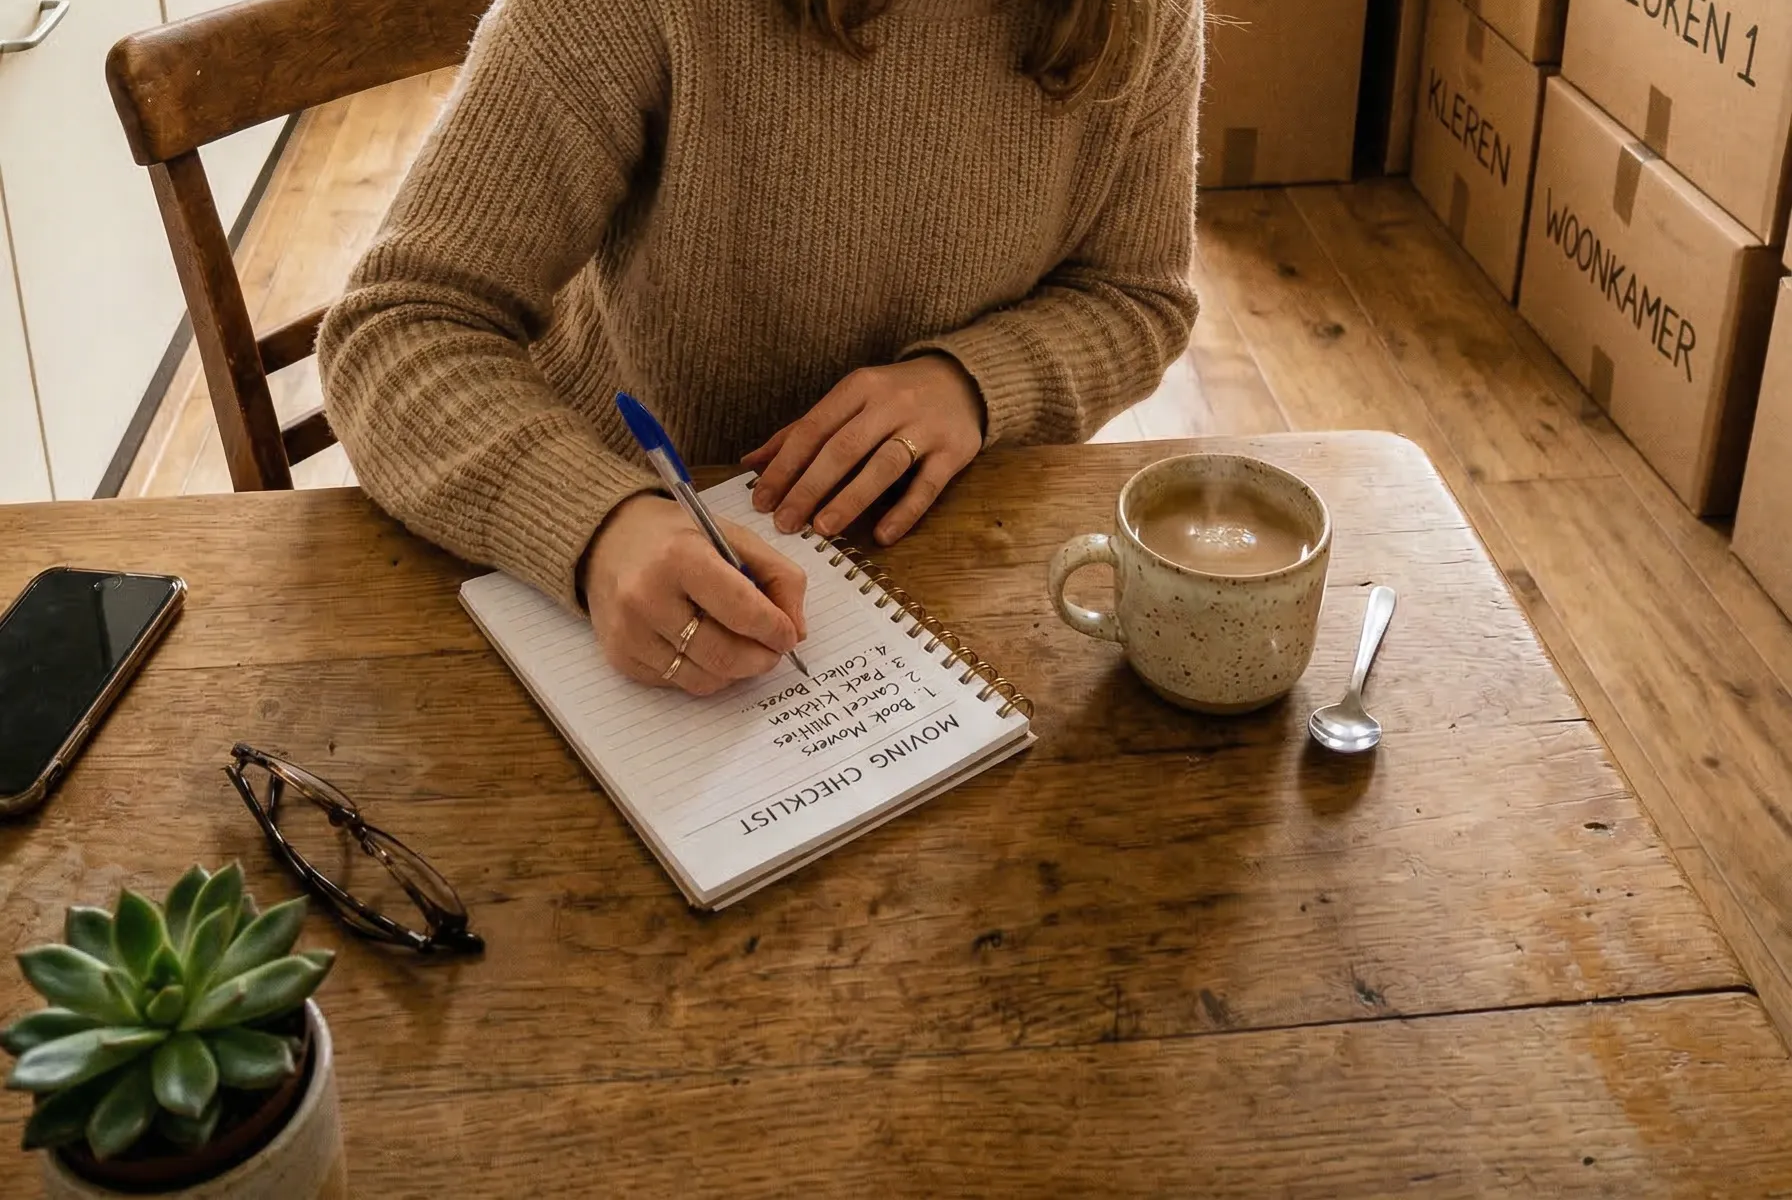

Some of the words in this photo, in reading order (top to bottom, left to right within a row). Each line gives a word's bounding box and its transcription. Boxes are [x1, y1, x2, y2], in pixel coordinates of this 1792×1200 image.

[1737, 24, 1759, 88] 1
[1428, 67, 1512, 188] KLEREN
[1546, 186, 1697, 383] WOONKAMER
[839, 668, 886, 694] Pack
[842, 682, 900, 718] Cancel
[868, 697, 916, 724] Book
[869, 713, 960, 769] MOVING
[740, 767, 863, 836] CHECKLIST
